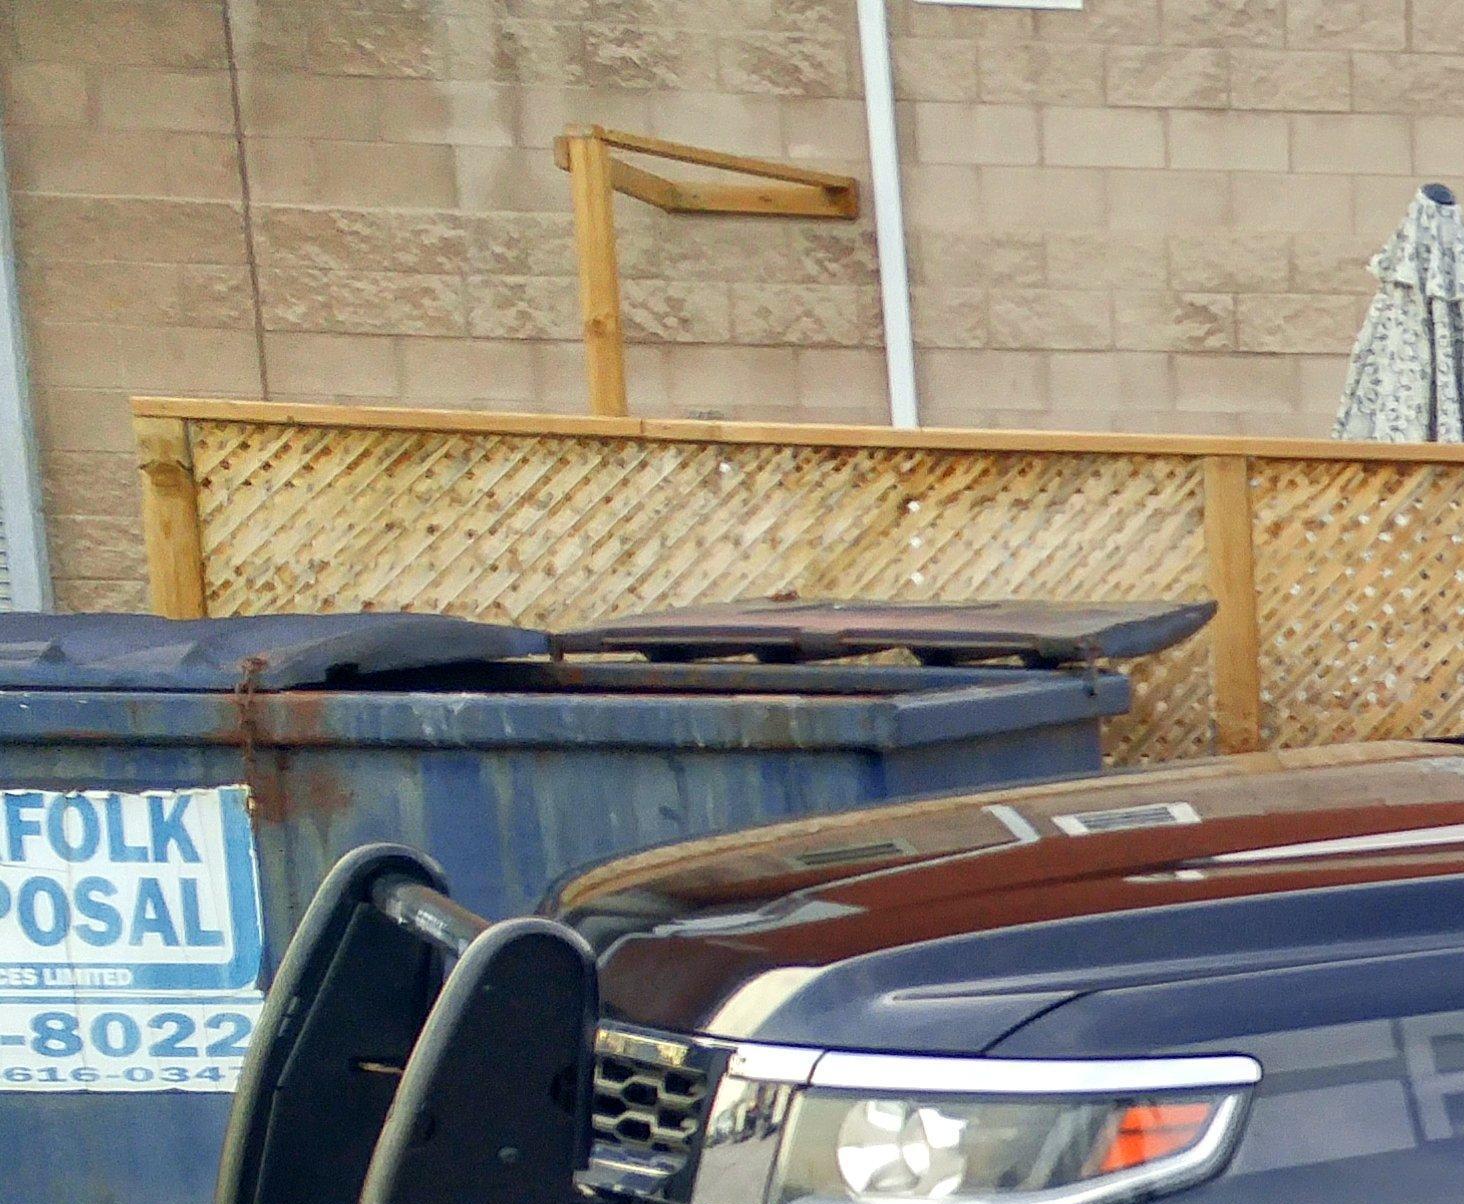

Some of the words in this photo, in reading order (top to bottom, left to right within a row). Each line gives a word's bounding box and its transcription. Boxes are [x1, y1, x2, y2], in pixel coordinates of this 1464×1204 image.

[5, 792, 202, 863] FOLK
[0, 876, 225, 948] OSAL
[43, 967, 132, 986] LIMITED
